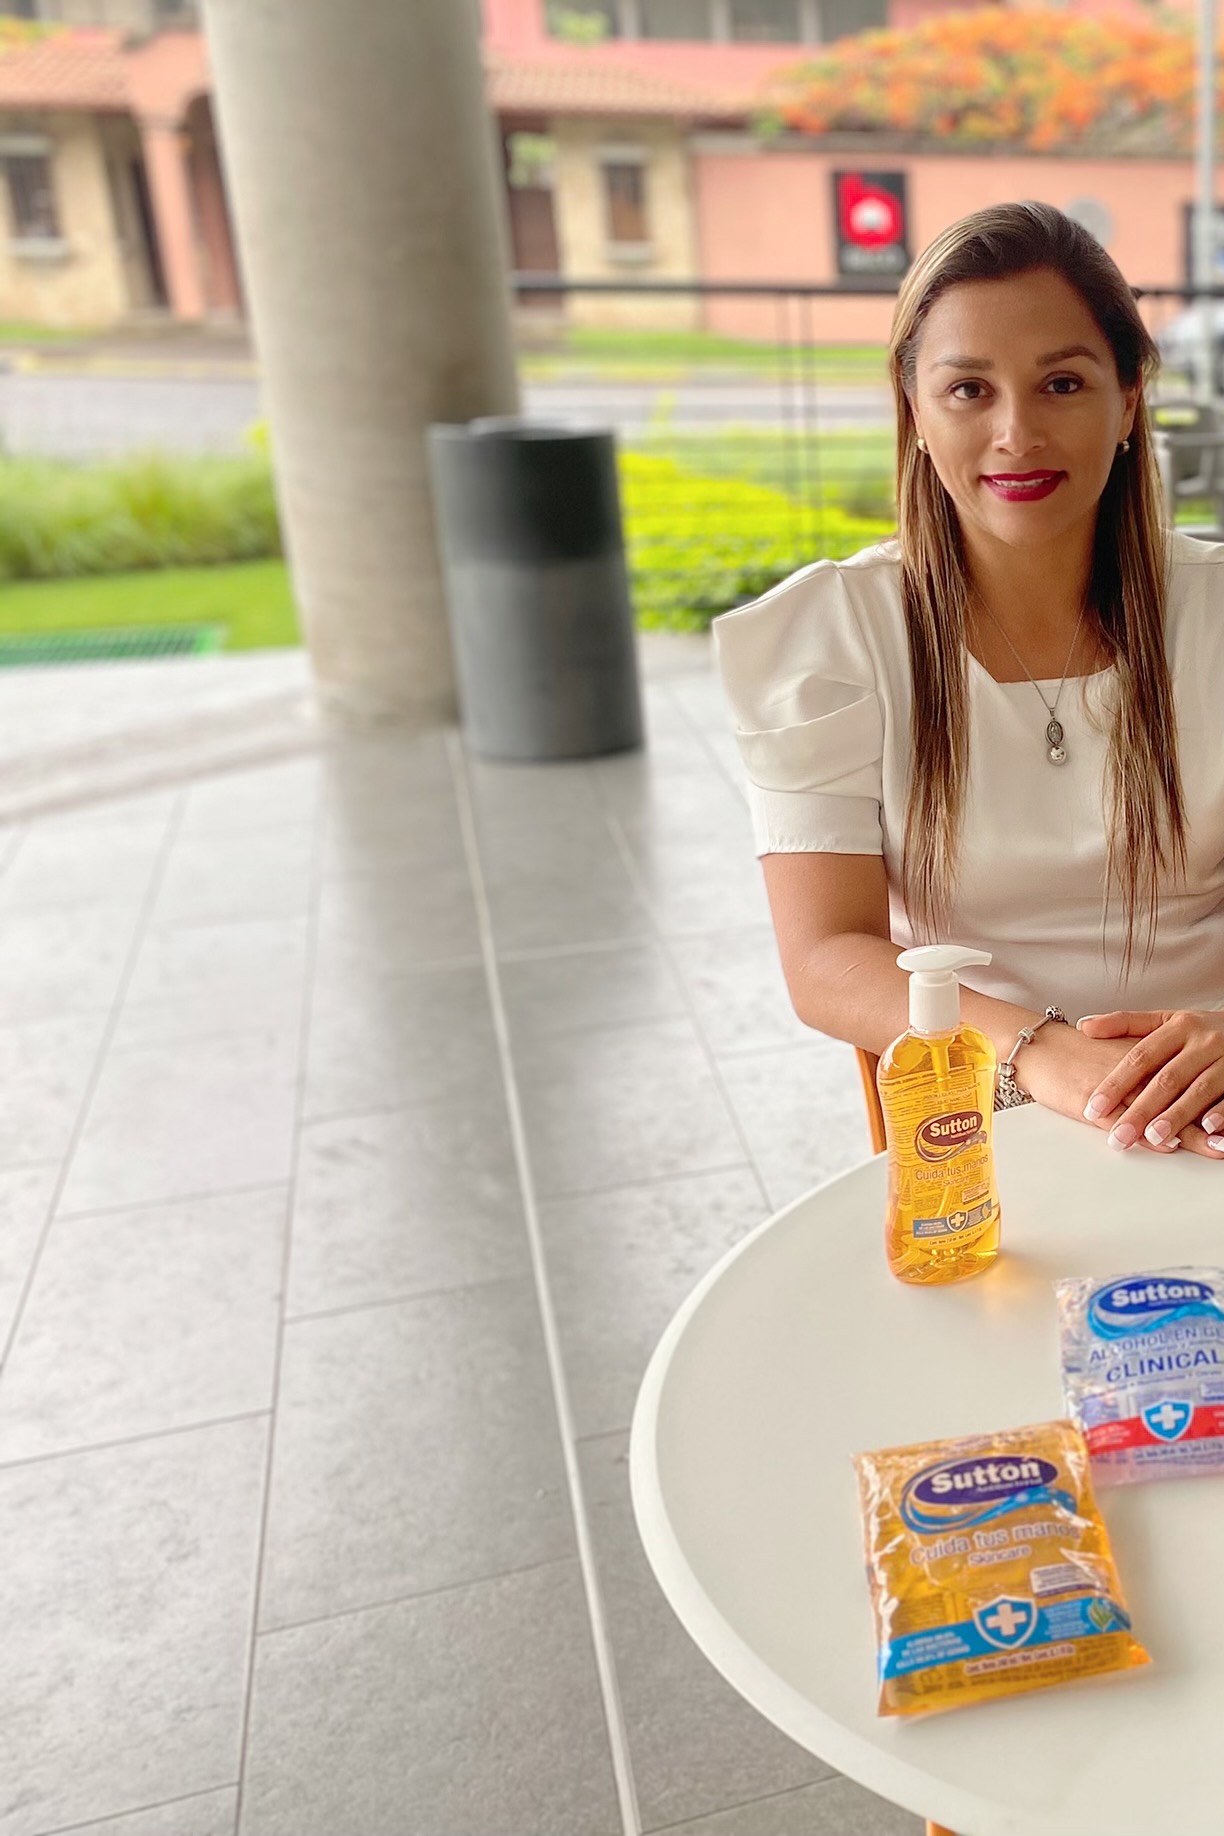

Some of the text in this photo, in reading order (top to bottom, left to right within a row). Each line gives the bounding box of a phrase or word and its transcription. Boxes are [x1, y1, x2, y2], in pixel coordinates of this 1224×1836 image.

[930, 1115, 977, 1137] Sutton
[915, 1154, 989, 1180] Cuida tus manos
[1111, 1283, 1201, 1307] Sutton
[1174, 1327, 1198, 1341] EN
[931, 1462, 1040, 1493] Sutton
[911, 1537, 969, 1564] Cuida
[975, 1530, 1008, 1548] tus
